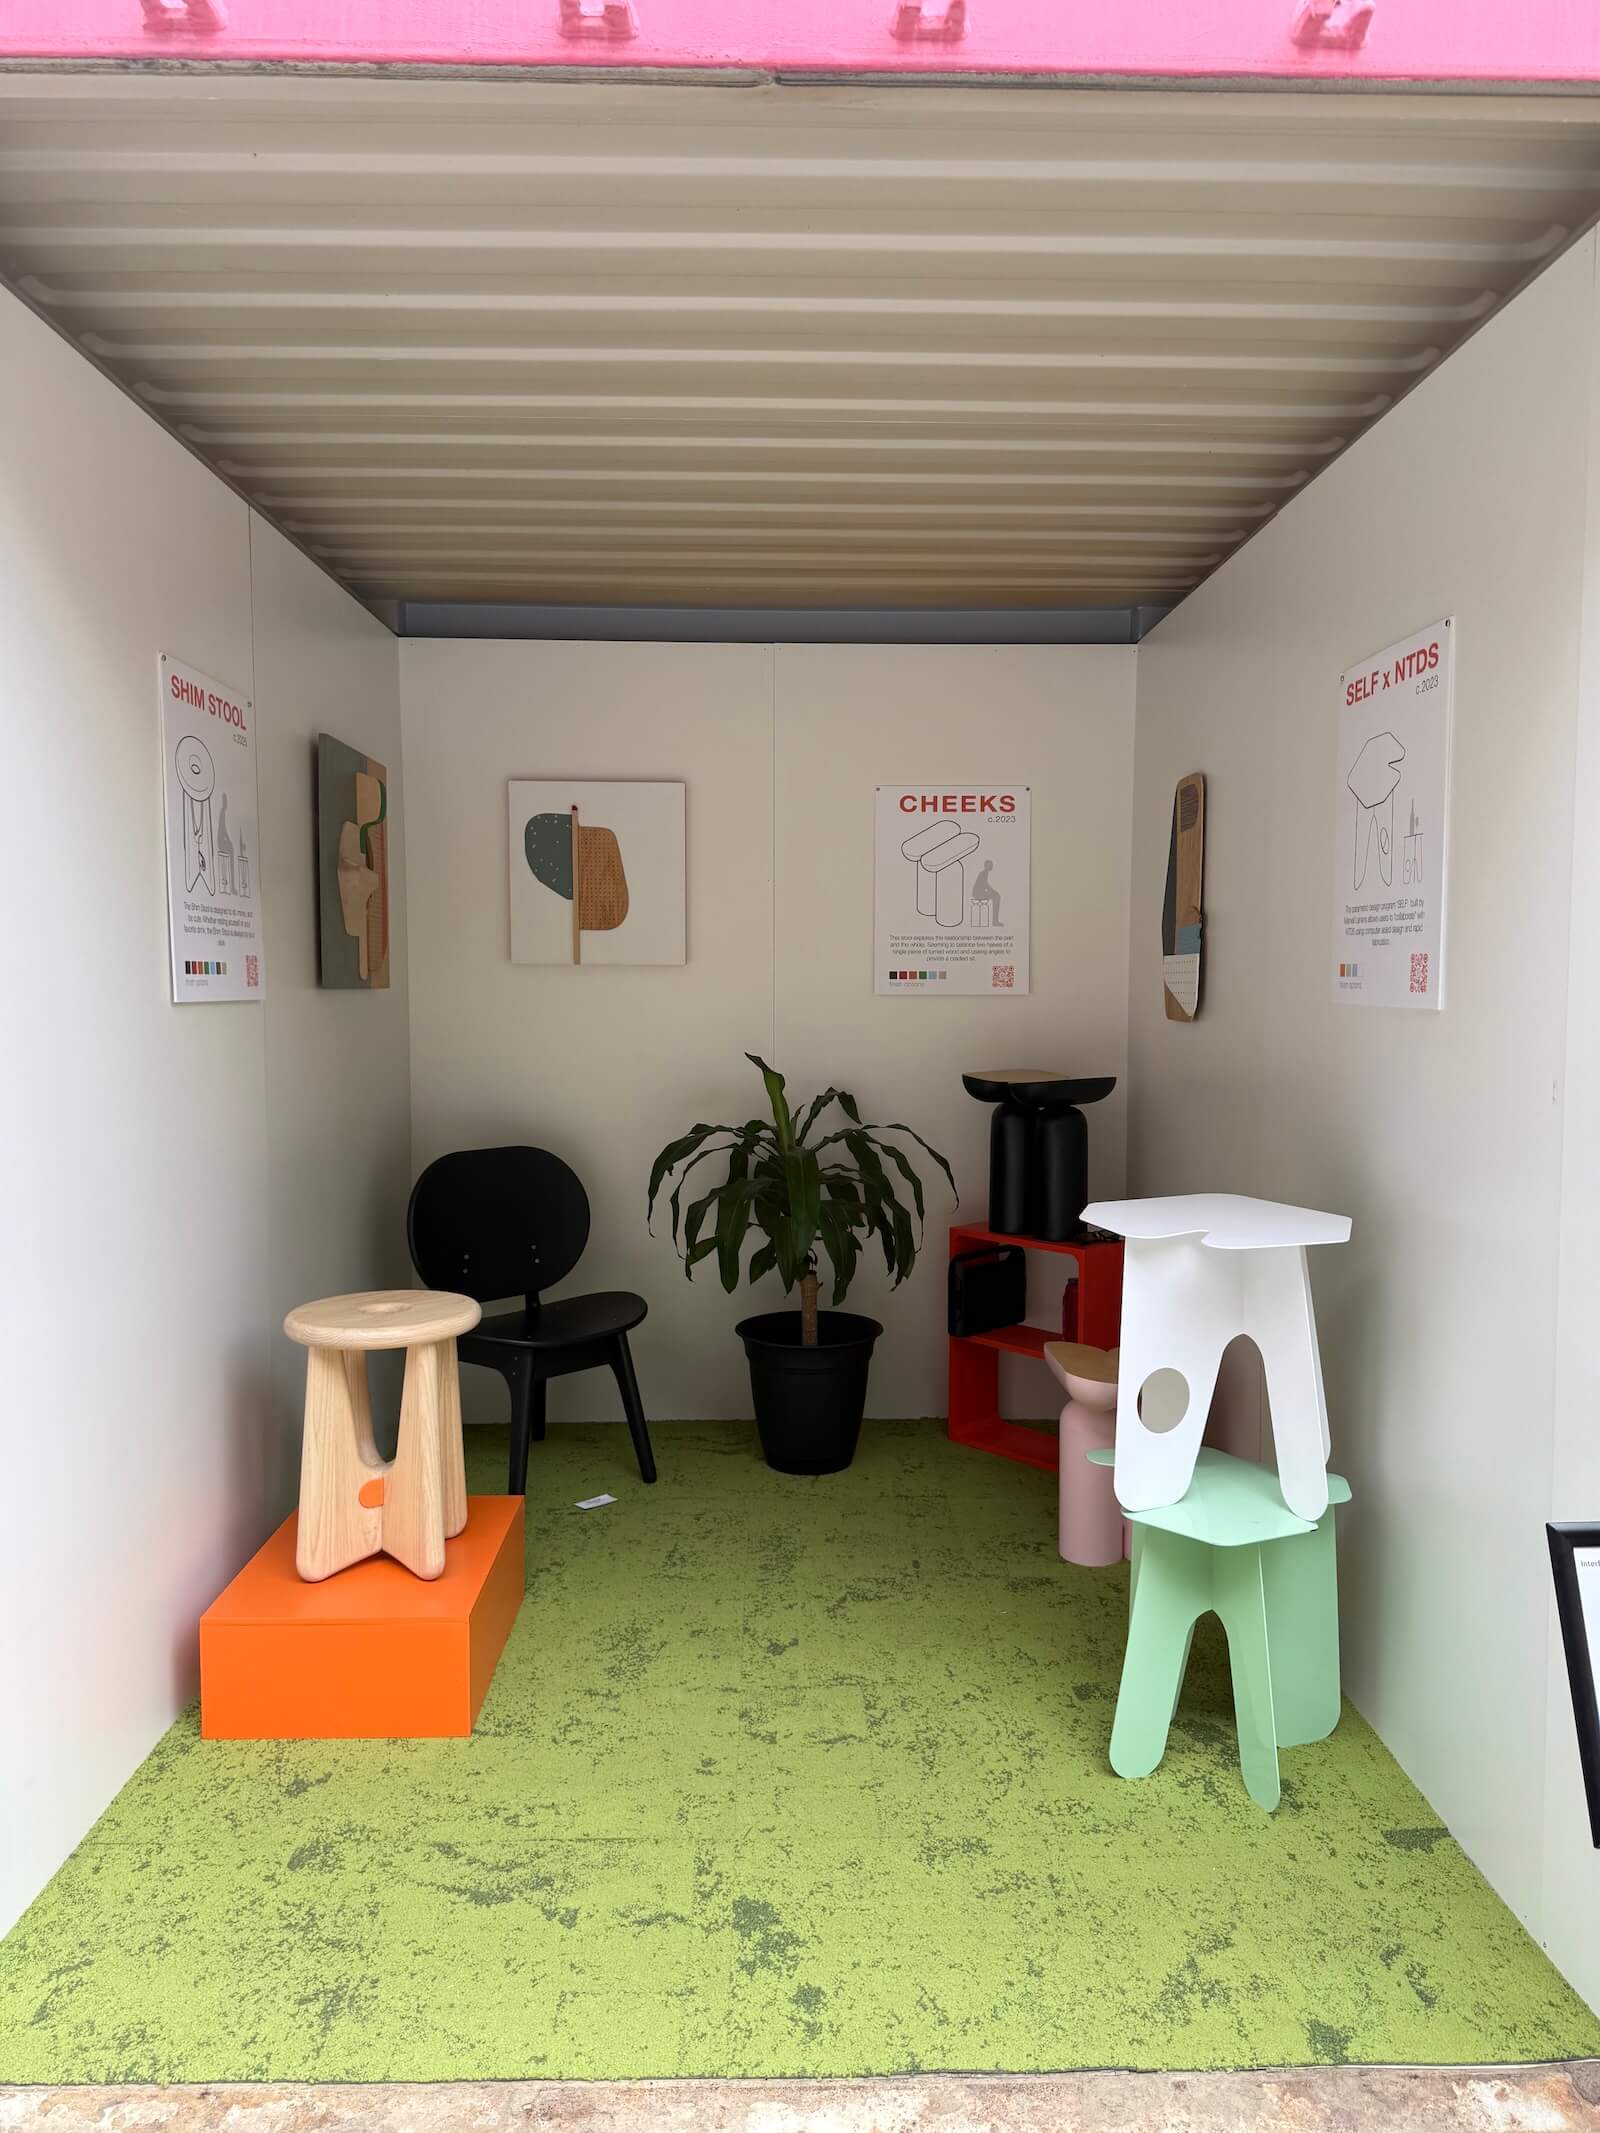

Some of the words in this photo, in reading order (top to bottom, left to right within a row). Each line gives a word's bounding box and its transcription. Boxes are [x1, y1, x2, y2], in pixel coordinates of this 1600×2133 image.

[1346, 670, 1379, 706] SELF
[1382, 670, 1391, 690] x
[1394, 642, 1439, 685] NTDS
[1415, 674, 1440, 695] c.2023
[171, 674, 205, 711] SHIM
[208, 693, 247, 731] STOOL
[899, 795, 1016, 813] CHEEKS
[987, 815, 1016, 823] c.2023
